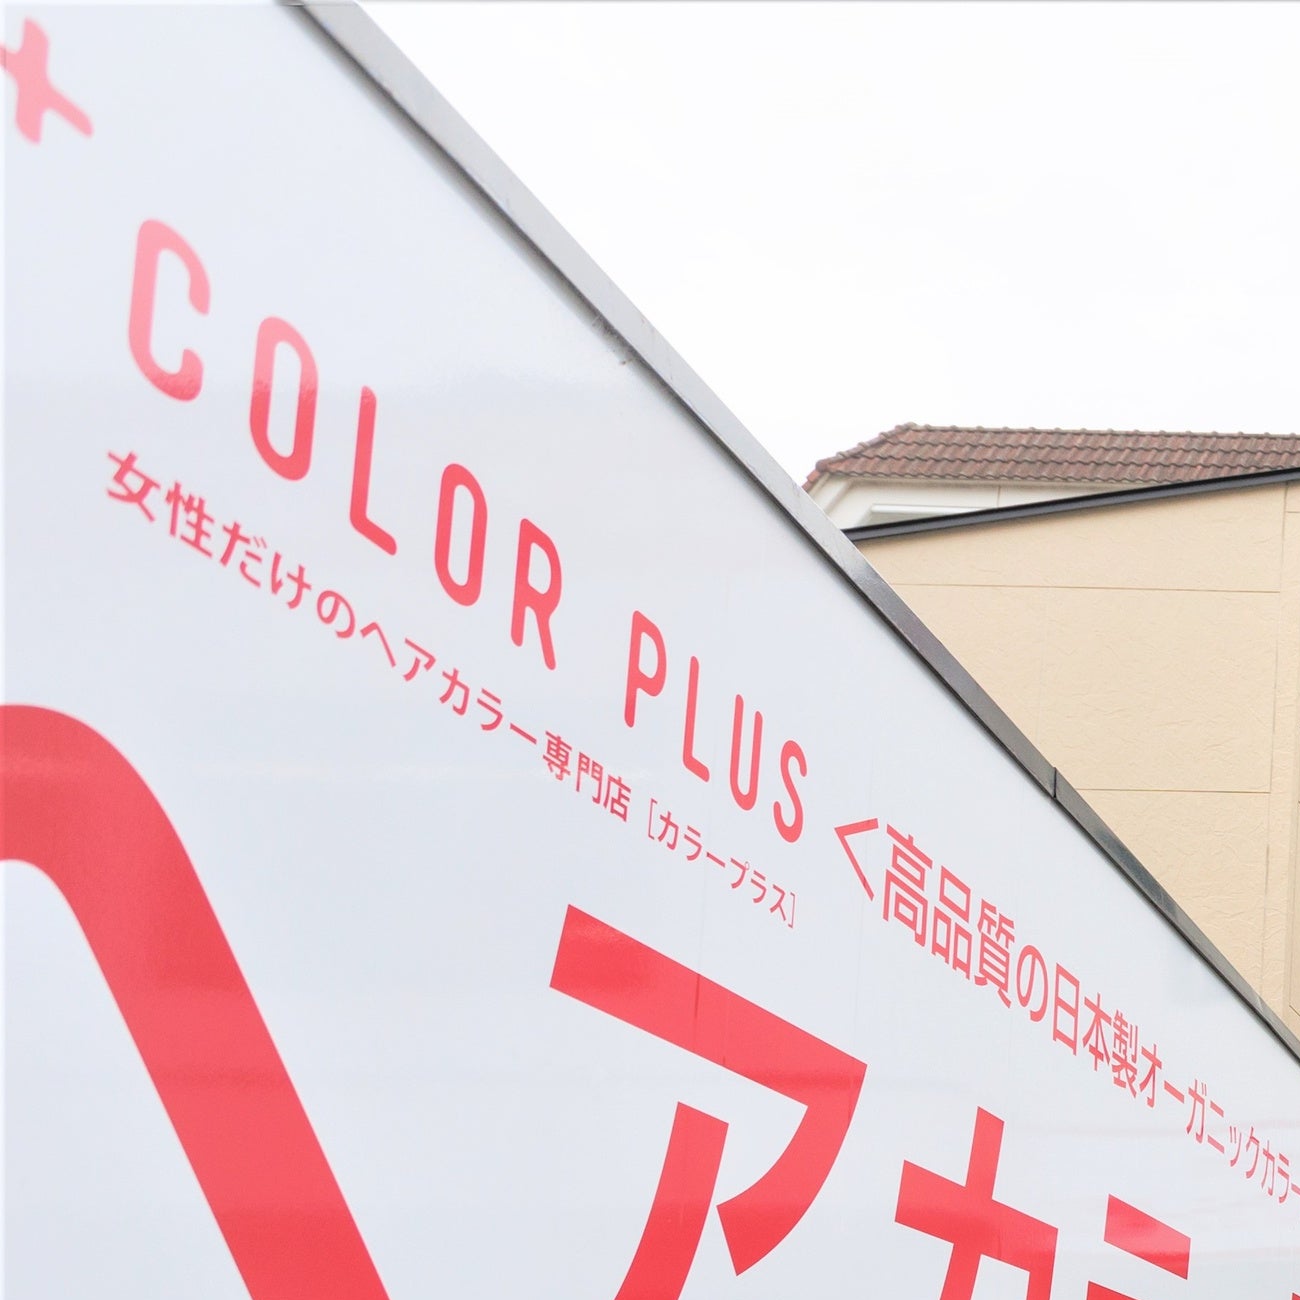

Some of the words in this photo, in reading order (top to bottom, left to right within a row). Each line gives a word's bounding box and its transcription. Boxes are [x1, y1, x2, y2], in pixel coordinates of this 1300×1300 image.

[105, 450, 632, 823] 女性だけのヘアカラー専門店
[128, 219, 562, 670] COLOR
[624, 610, 808, 843] PLUS
